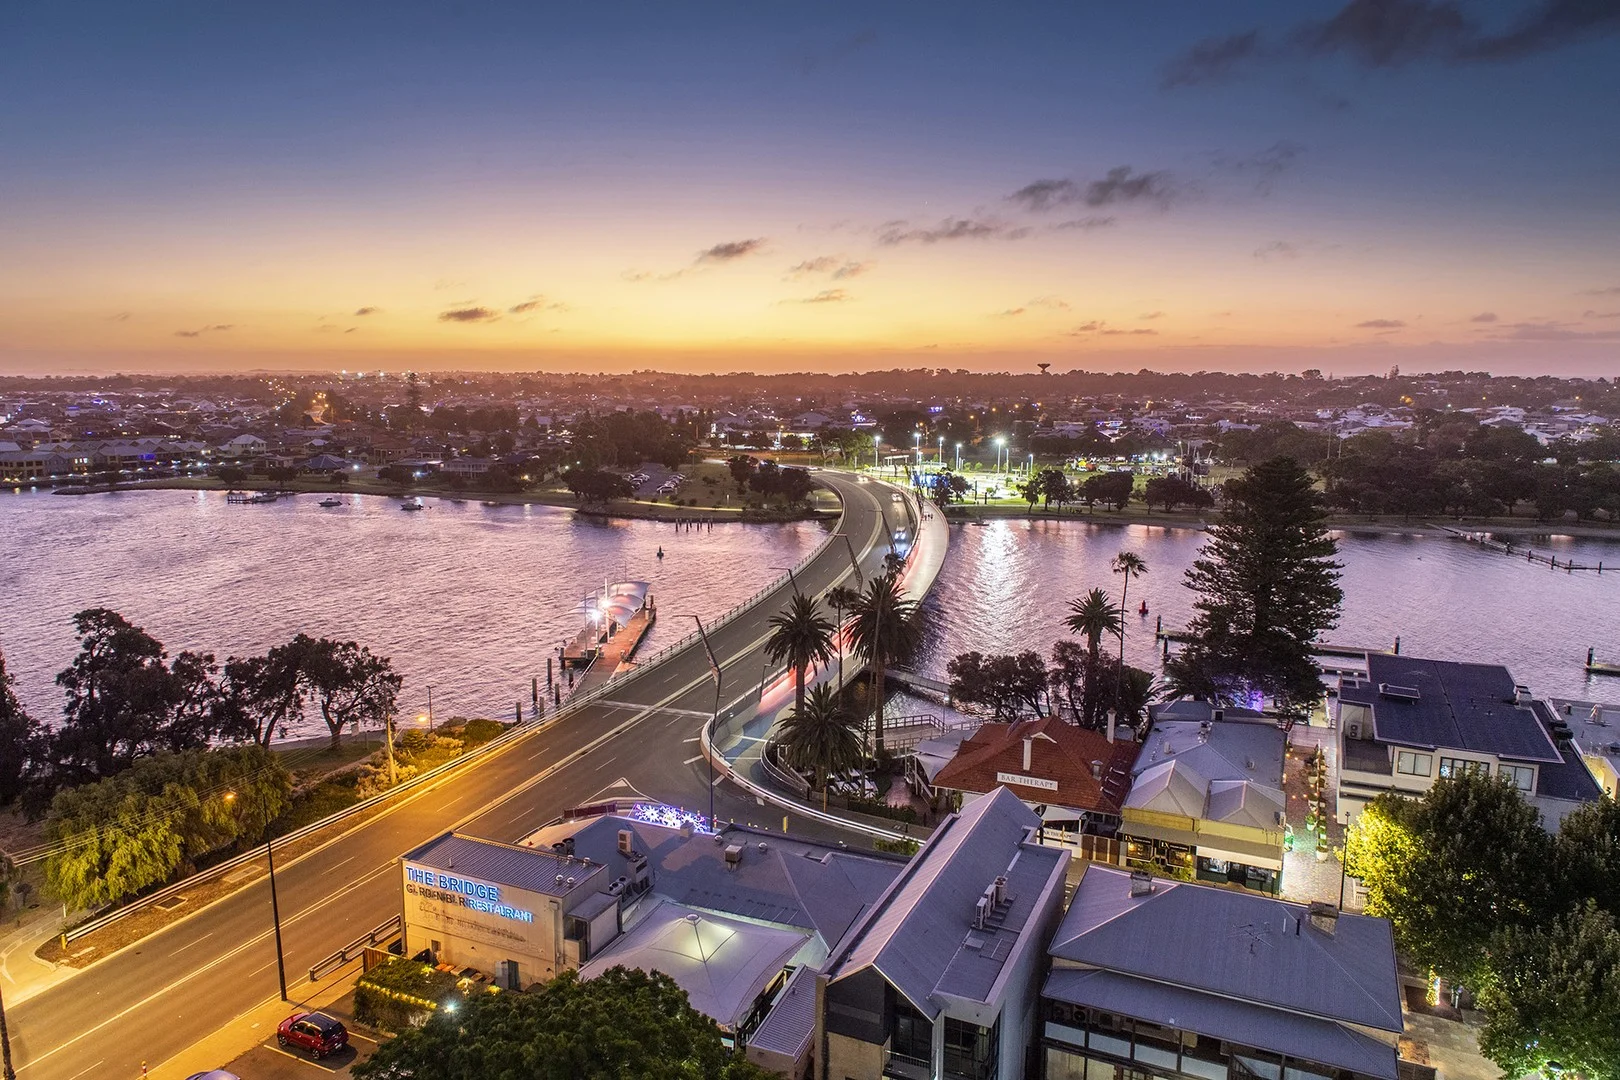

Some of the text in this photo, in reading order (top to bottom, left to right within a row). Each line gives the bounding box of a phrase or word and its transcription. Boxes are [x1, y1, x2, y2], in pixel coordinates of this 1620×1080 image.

[1001, 775, 1054, 789] BAR THERAPY
[405, 866, 500, 902] THE BRIDGE
[468, 897, 533, 922] RESTAURANT
